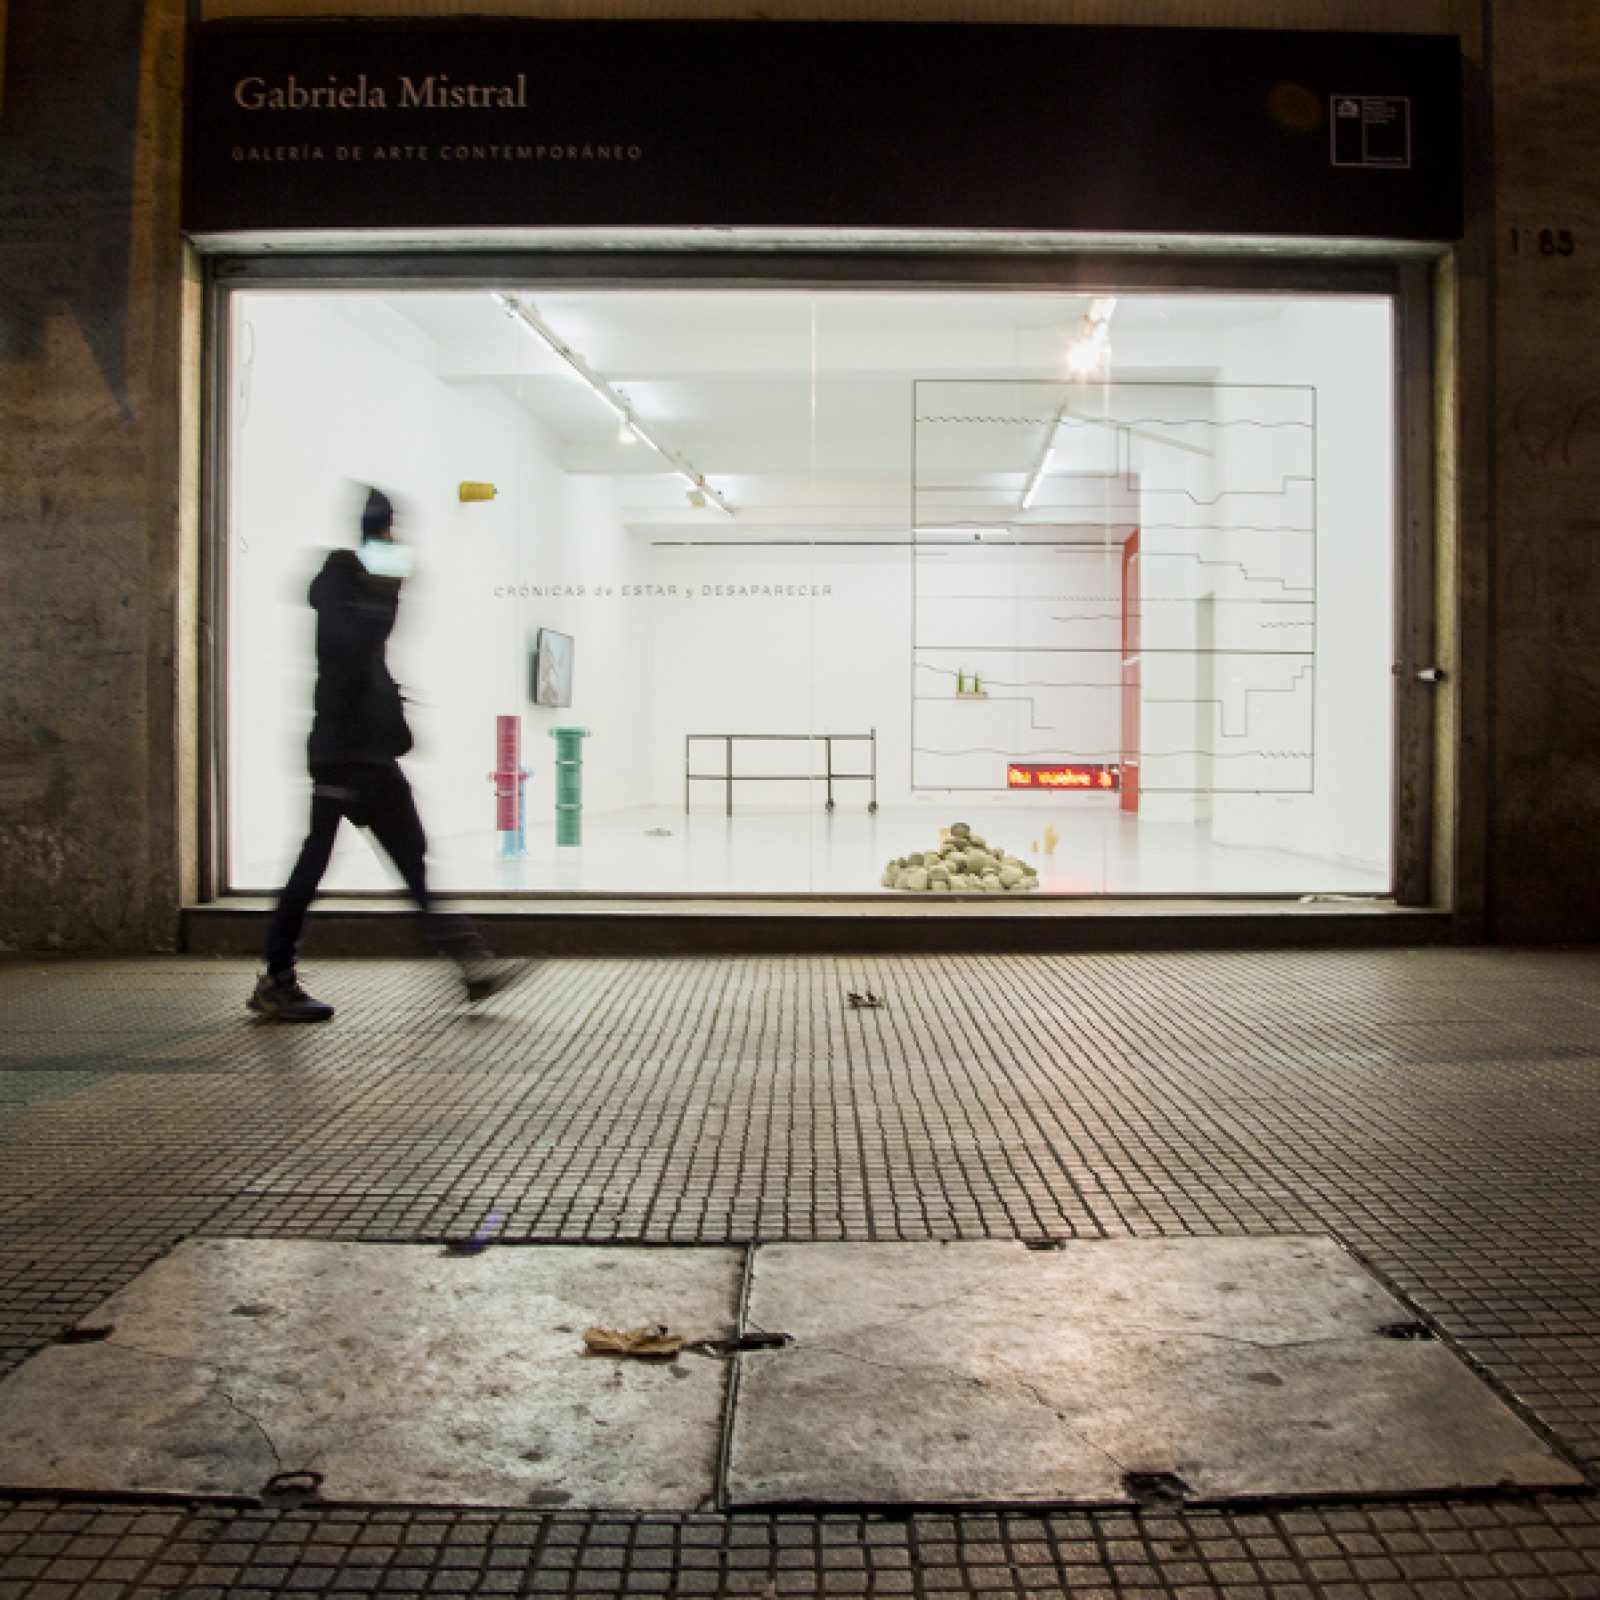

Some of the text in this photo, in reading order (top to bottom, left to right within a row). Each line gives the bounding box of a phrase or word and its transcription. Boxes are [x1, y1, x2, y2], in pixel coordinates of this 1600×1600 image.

[234, 73, 527, 110] Gabriela Mistral
[231, 143, 642, 161] GALERÍA DE ARTE CONTEMPORÁNEO
[493, 581, 586, 598] CRÓNICAS
[593, 585, 613, 597] de
[621, 584, 678, 597] ESTAR
[701, 584, 832, 597] DESAPARECER
